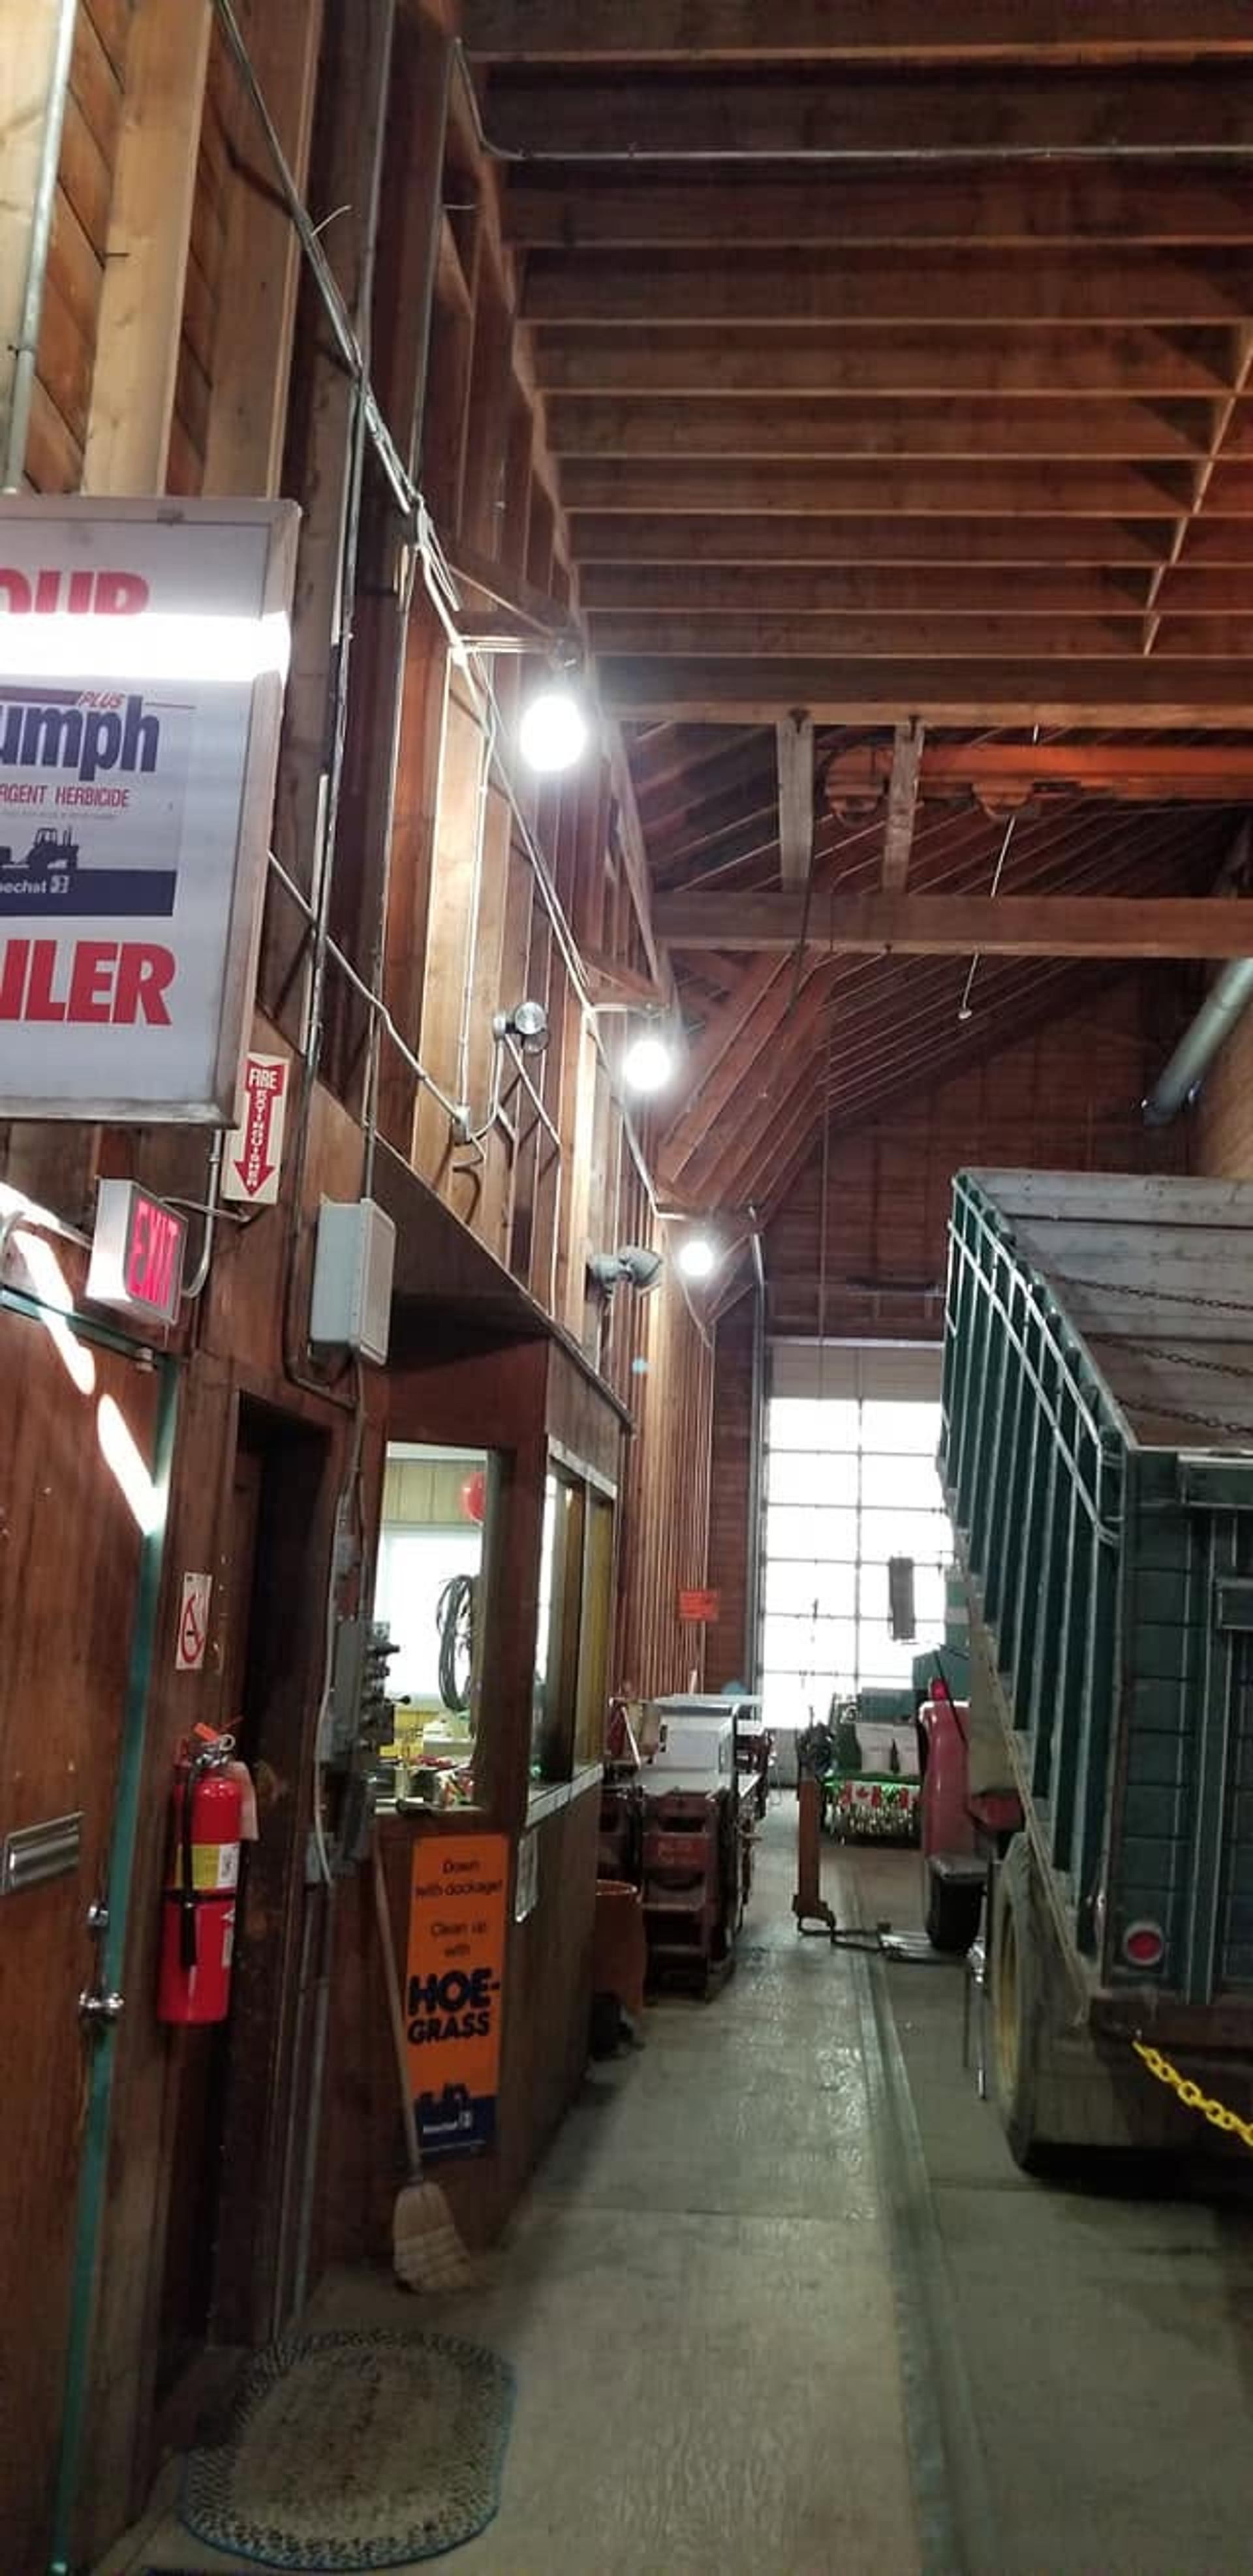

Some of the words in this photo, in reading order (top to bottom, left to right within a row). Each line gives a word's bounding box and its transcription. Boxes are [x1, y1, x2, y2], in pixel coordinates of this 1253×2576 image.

[78, 691, 124, 709] PLUS
[55, 786, 129, 808] HERBICIDE
[249, 1067, 277, 1090] FIRE
[128, 1197, 181, 1309] EXIT
[409, 1967, 501, 2016] HOE-
[408, 2011, 491, 2045] GRASS
